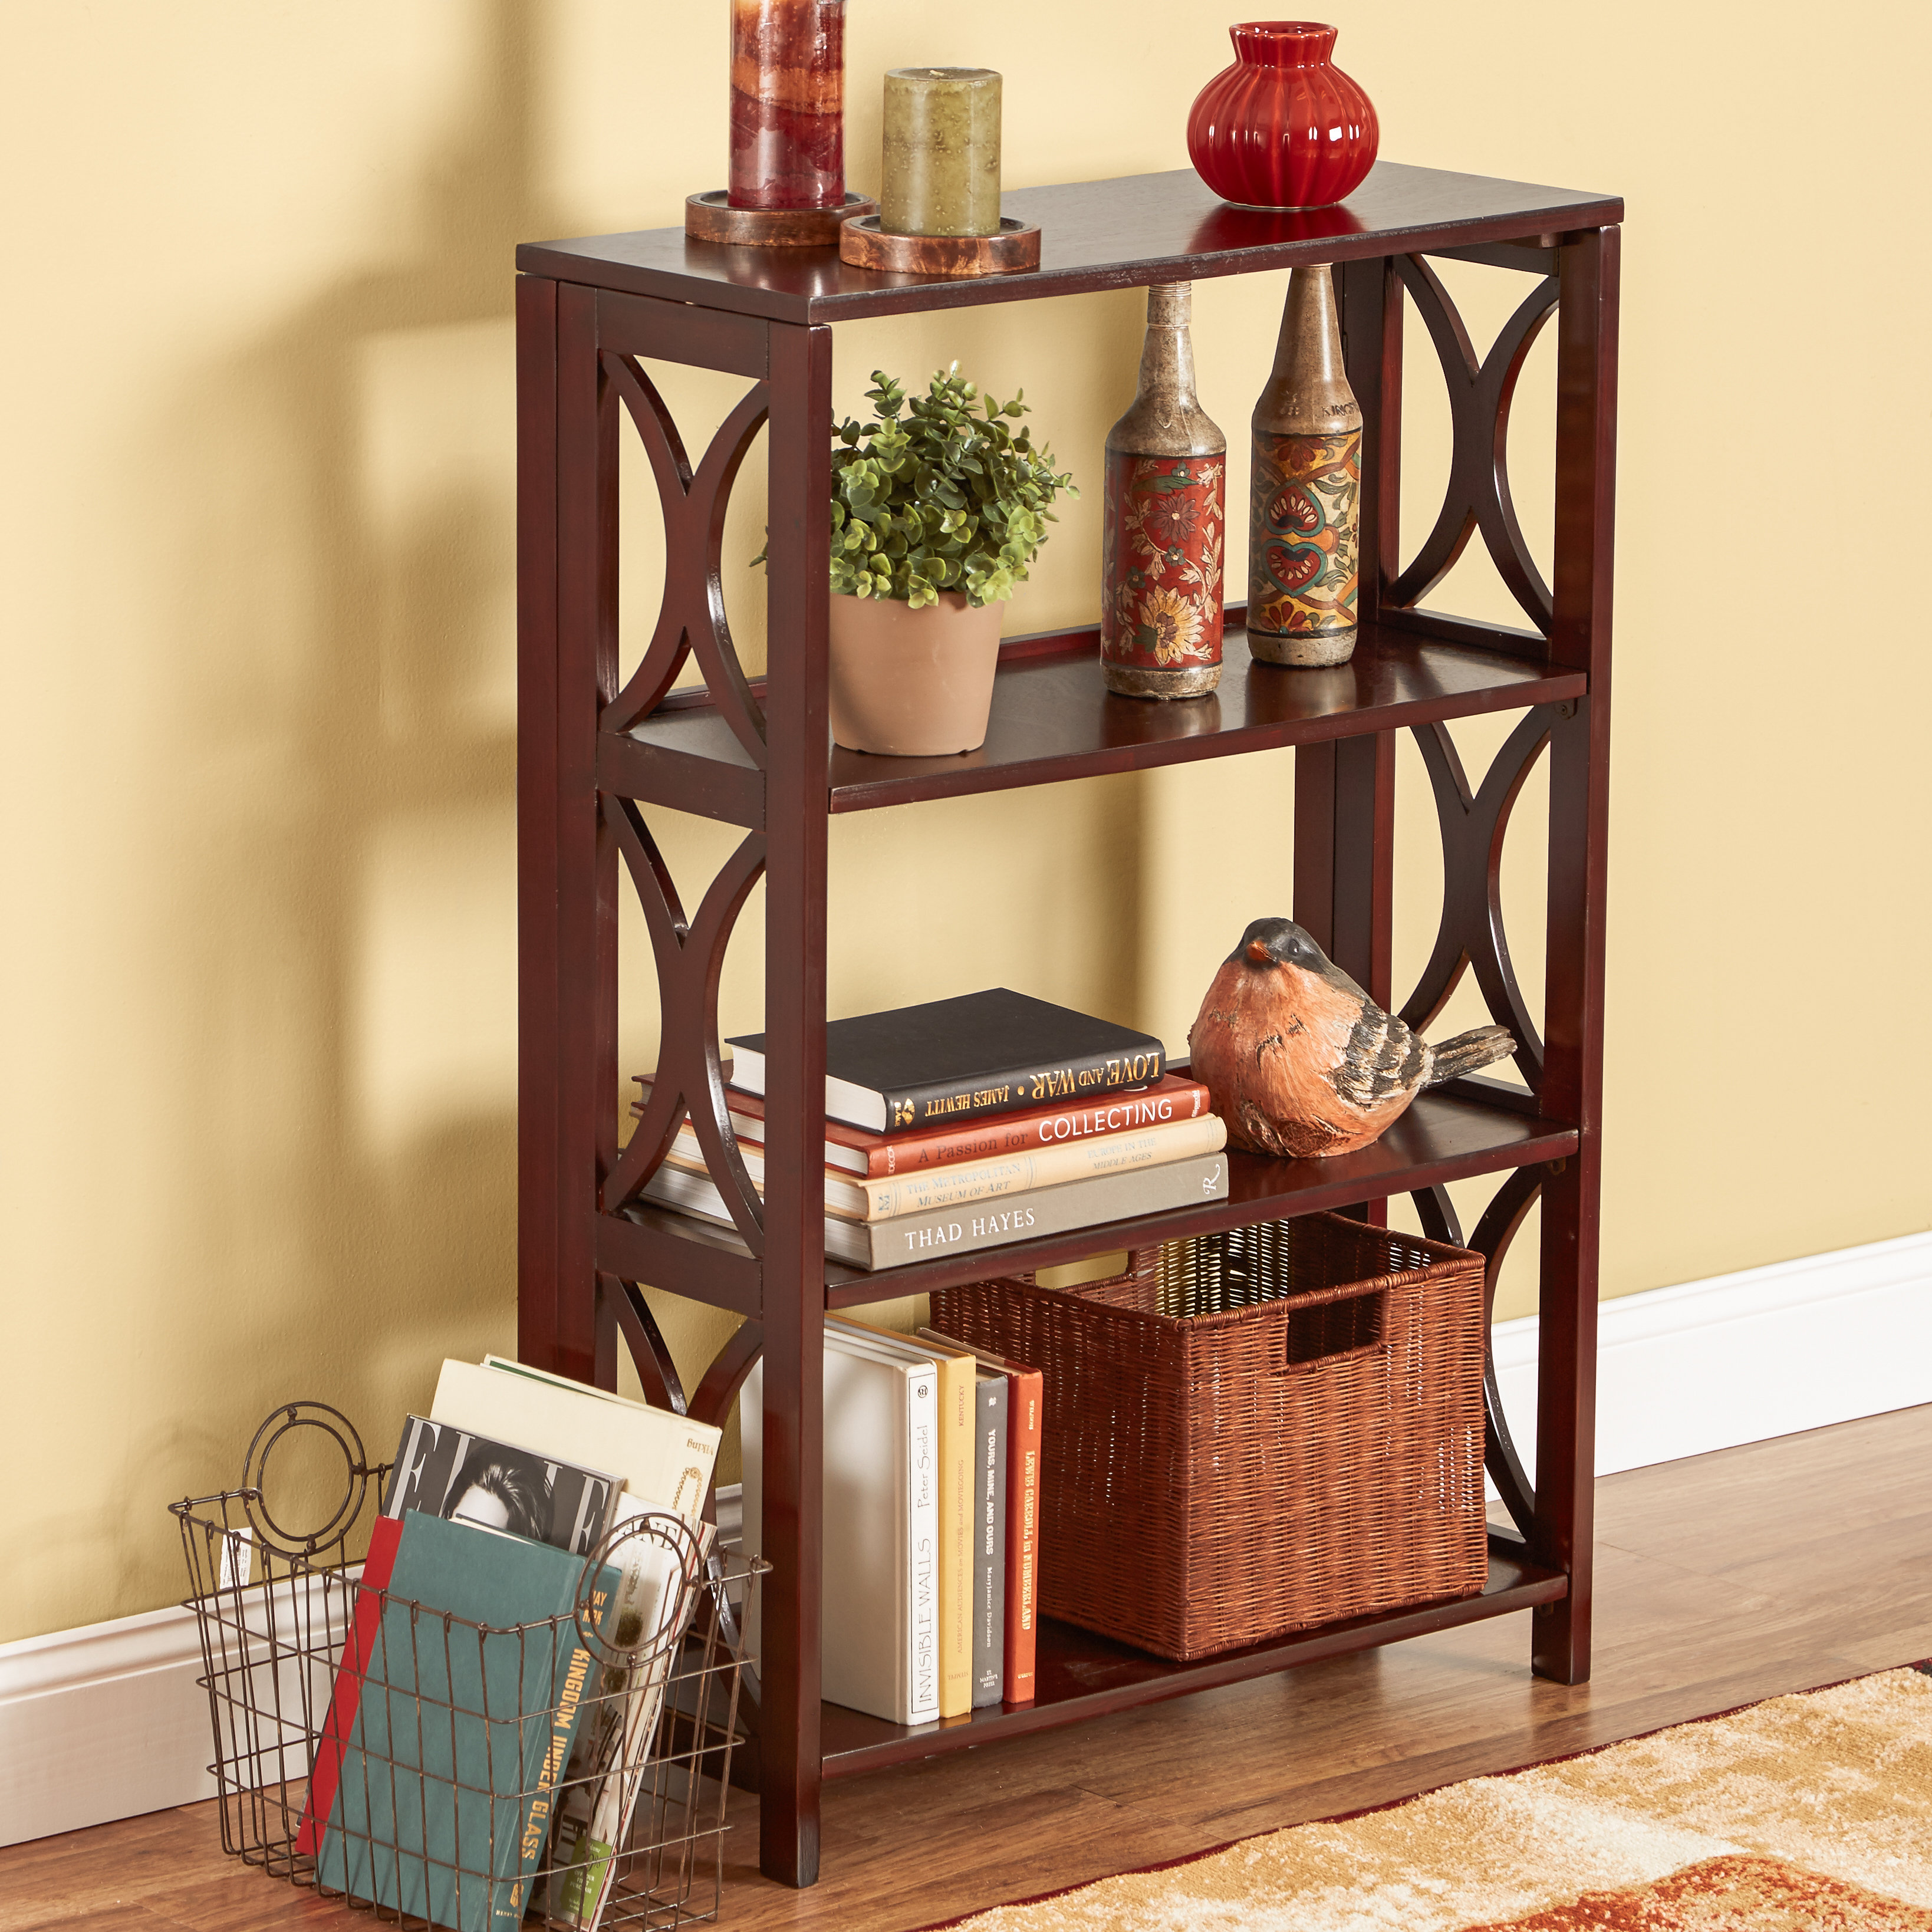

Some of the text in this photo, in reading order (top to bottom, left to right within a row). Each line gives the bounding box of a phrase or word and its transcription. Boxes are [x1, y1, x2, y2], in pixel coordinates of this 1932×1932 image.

[1029, 1052, 1160, 1099] LOVE AND WAR
[924, 1085, 1010, 1117] JAMES HEWITT
[919, 1098, 1173, 1163] A Passion for COLLECTING
[1087, 1138, 1157, 1159] EUROPE IN THE
[906, 1163, 1021, 1195] THE METROPOLITAN
[1093, 1152, 1152, 1170] MIDDLE AGES
[917, 1181, 1011, 1207] MUSEUM OF ART
[904, 1207, 1035, 1250] THAD HAYES
[686, 1439, 713, 1456] Viking
[917, 1424, 930, 1508] Peter Seidel
[389, 1416, 608, 1554] ELE
[1025, 1450, 1035, 1487] LEWIS
[986, 1428, 996, 1556] YOURS, MINE, AND OURS
[959, 1558, 963, 1566] on
[1023, 1540, 1033, 1553] in
[917, 1538, 932, 1703] INVISIBLE WALLS
[554, 1648, 590, 1729] KINGDOM
[522, 1799, 549, 1860] GLASS
